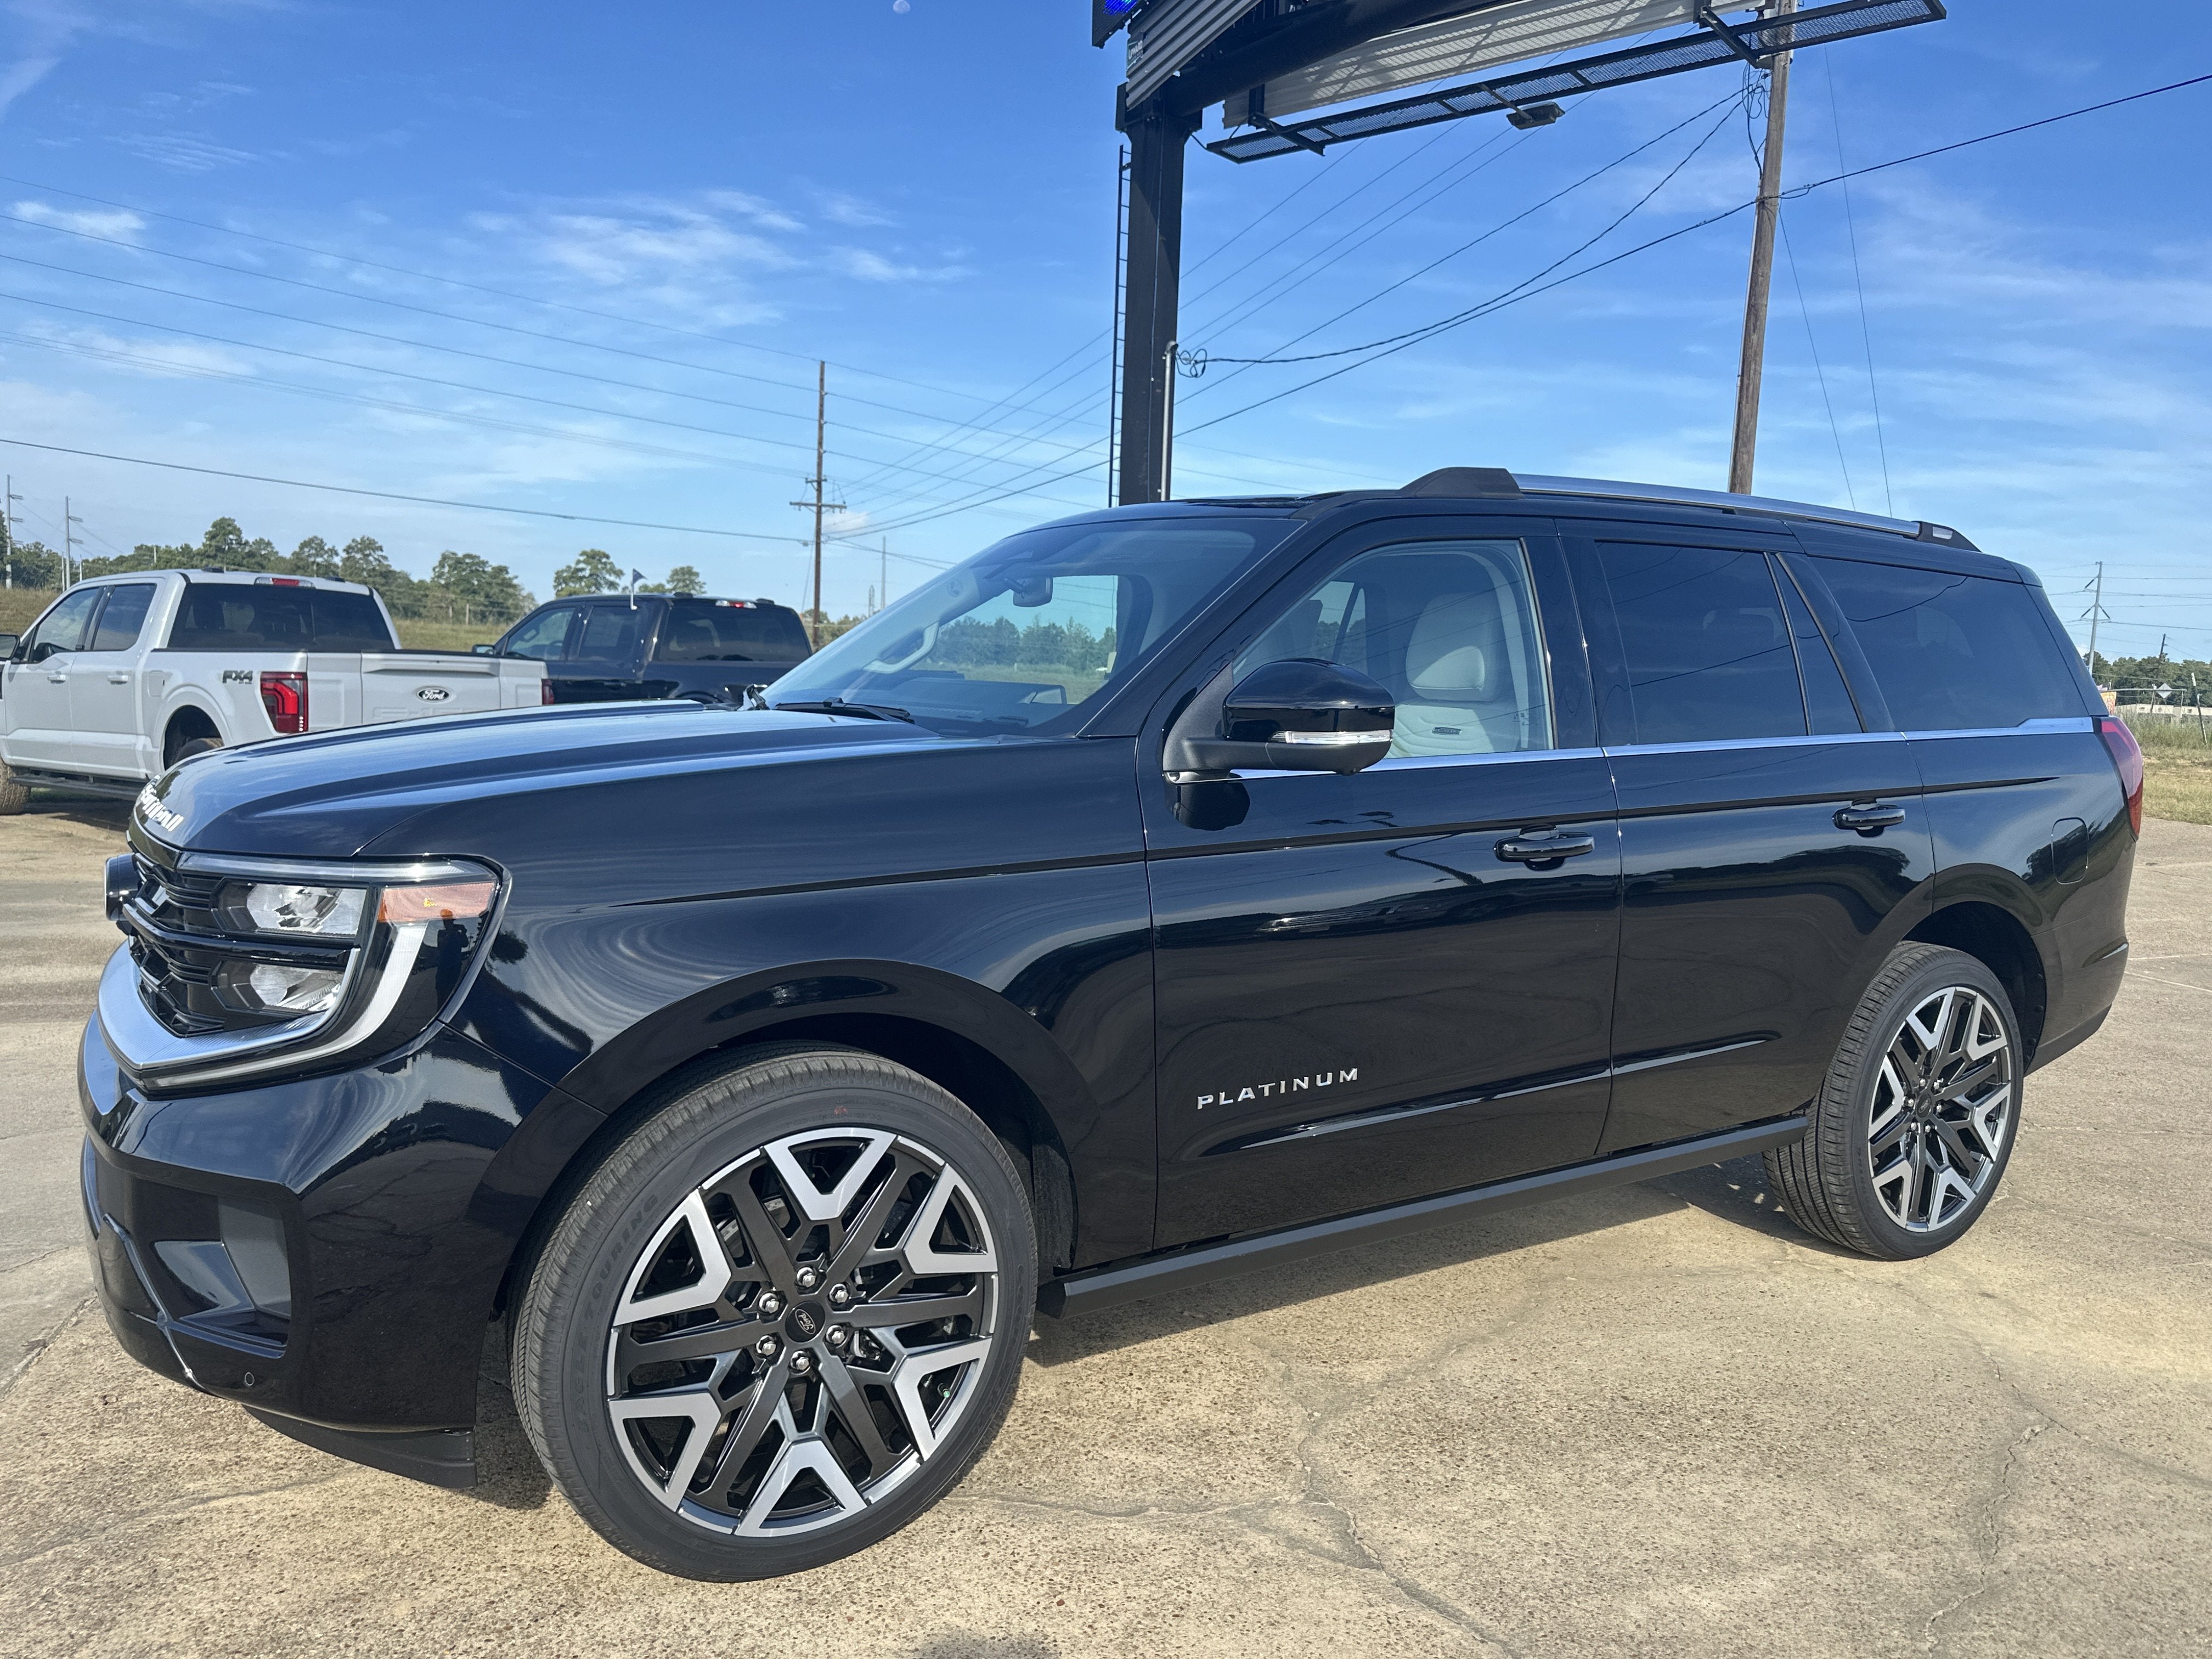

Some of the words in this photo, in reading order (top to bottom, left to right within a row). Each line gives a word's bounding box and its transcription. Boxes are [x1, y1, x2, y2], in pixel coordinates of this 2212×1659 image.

[222, 670, 253, 684] FX4
[420, 689, 446, 701] Ford
[1197, 1068, 1358, 1109] PLATINUM
[583, 1193, 658, 1320] TOURING
[797, 1311, 815, 1331] Ford
